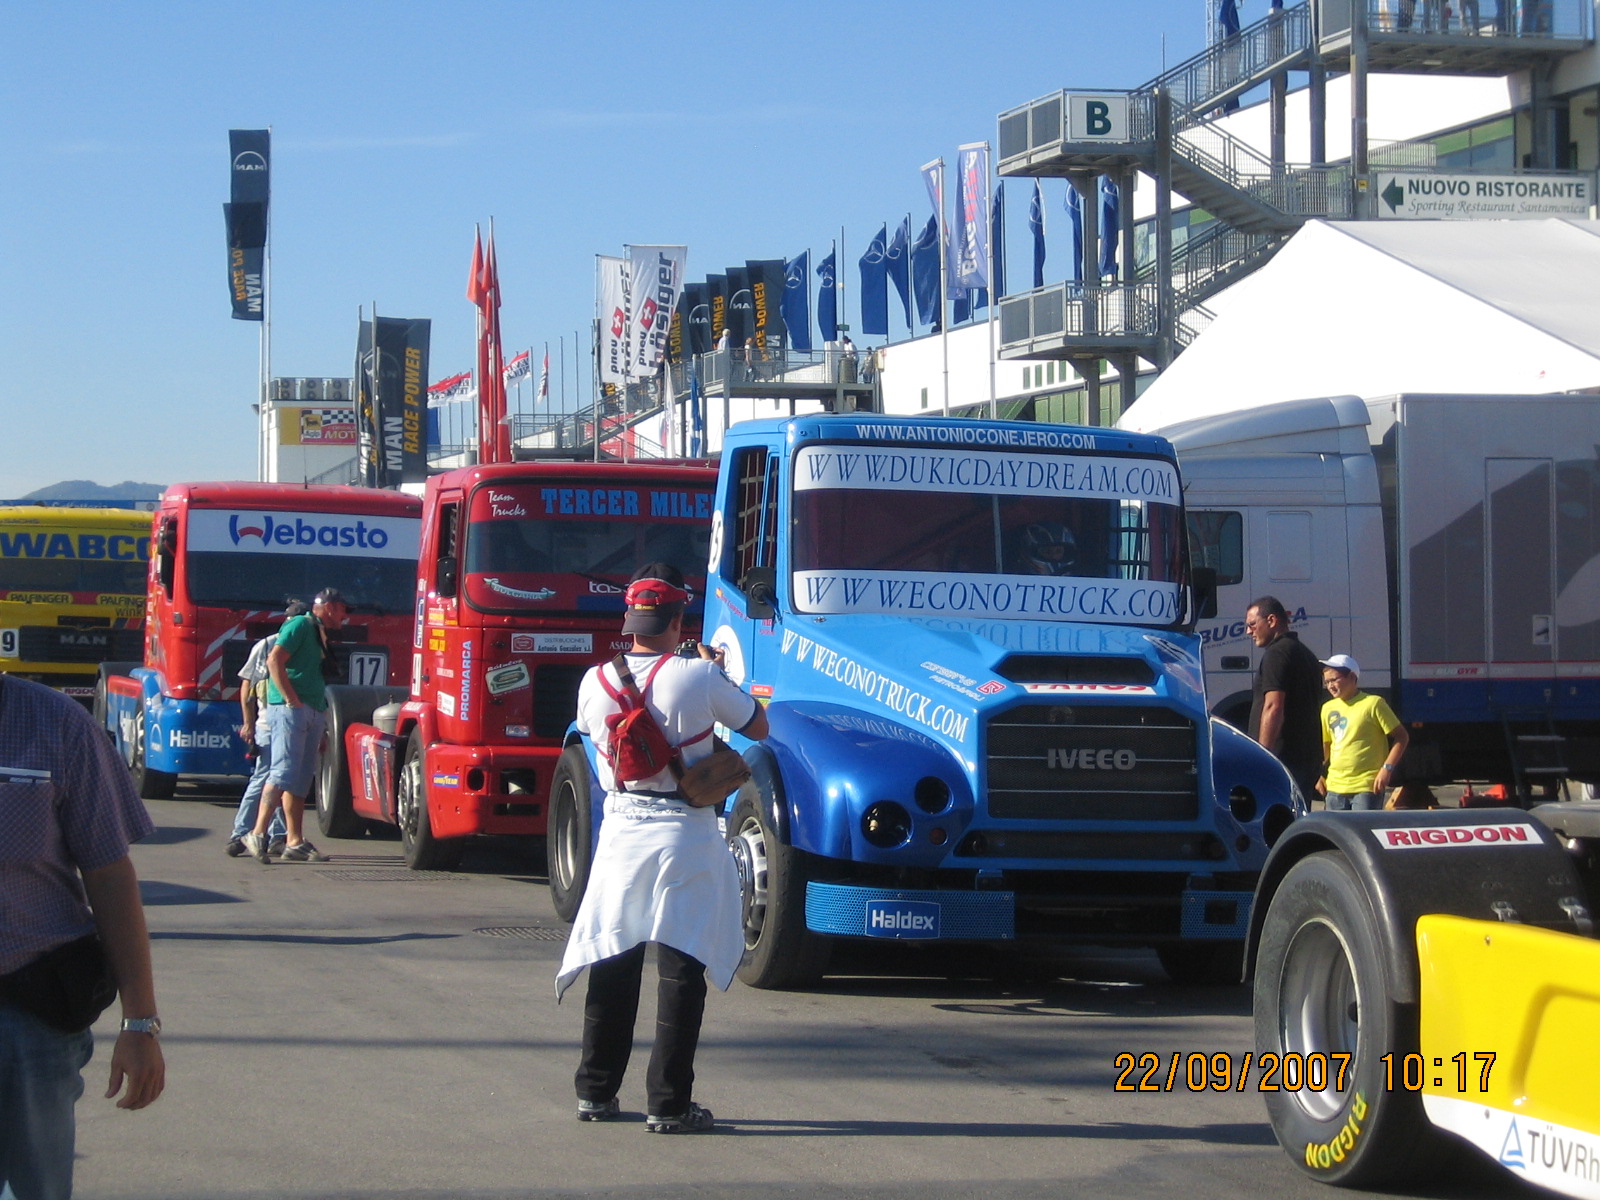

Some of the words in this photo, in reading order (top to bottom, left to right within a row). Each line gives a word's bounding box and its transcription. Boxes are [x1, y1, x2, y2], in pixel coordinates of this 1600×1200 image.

[1086, 101, 1111, 135] B
[1408, 179, 1470, 195] NUOVO
[1476, 182, 1585, 198] RISTORANTE
[1408, 200, 1454, 215] Sporting
[1458, 200, 1515, 213] Restaurant
[1517, 201, 1585, 214] Santamonica
[610, 339, 620, 374] pneu
[638, 331, 648, 367] pneu
[404, 347, 421, 406] POWER
[324, 431, 356, 439] MOT
[384, 416, 403, 471] MAN
[404, 408, 420, 454] RACE
[855, 424, 1096, 449] WWW.ANTONIOCONEJERO.COM
[808, 453, 1174, 499] WWW.DUKICDAYDREAM.COM
[488, 490, 514, 503] Team
[541, 488, 639, 516] TERCER
[650, 492, 716, 518] MILE
[491, 504, 527, 517] Trucks
[229, 513, 389, 549] Webasto
[10, 594, 69, 604] PALFINGER
[100, 595, 146, 607] PALFING
[2, 631, 15, 652] 9
[60, 634, 107, 645] MAN
[355, 657, 381, 686] 17
[460, 640, 472, 720] PROMARCA
[781, 628, 969, 743] WWW.ECONOTRUCK.COM
[169, 729, 231, 748] Haldex
[1047, 749, 1136, 770] IVECO
[1387, 826, 1528, 847] RIGDON
[872, 908, 934, 930] Haldex
[1304, 1092, 1370, 1170] RIGDON
